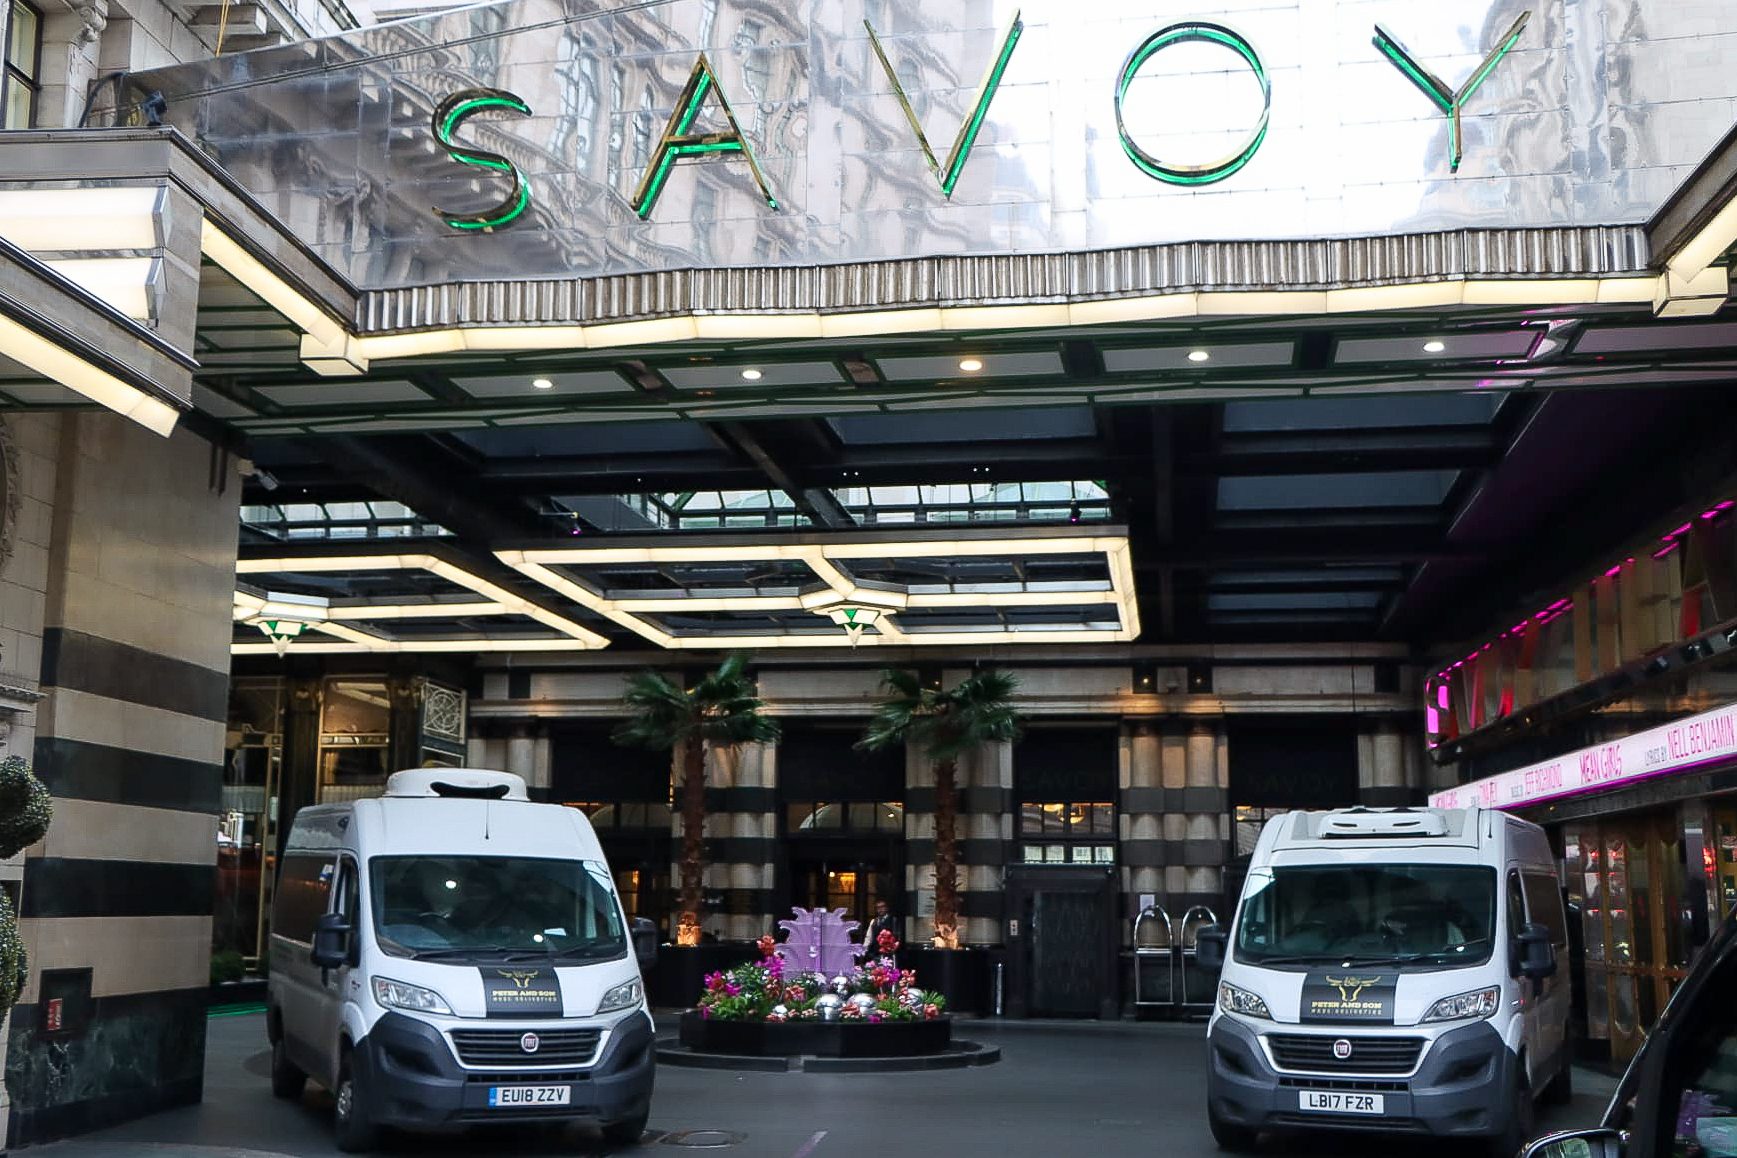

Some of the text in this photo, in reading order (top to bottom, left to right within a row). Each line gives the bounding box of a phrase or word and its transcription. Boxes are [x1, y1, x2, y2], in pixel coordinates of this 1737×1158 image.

[432, 8, 1530, 232] SAVOY
[1667, 728, 1689, 761] NELL
[1689, 713, 1735, 756] BENJAMIN
[1579, 750, 1600, 785] MEAN
[1340, 1001, 1362, 1009] AND
[501, 1089, 533, 1103] EU18
[537, 1088, 565, 1102] ZZV
[1309, 1093, 1374, 1110] LB17 FZR
